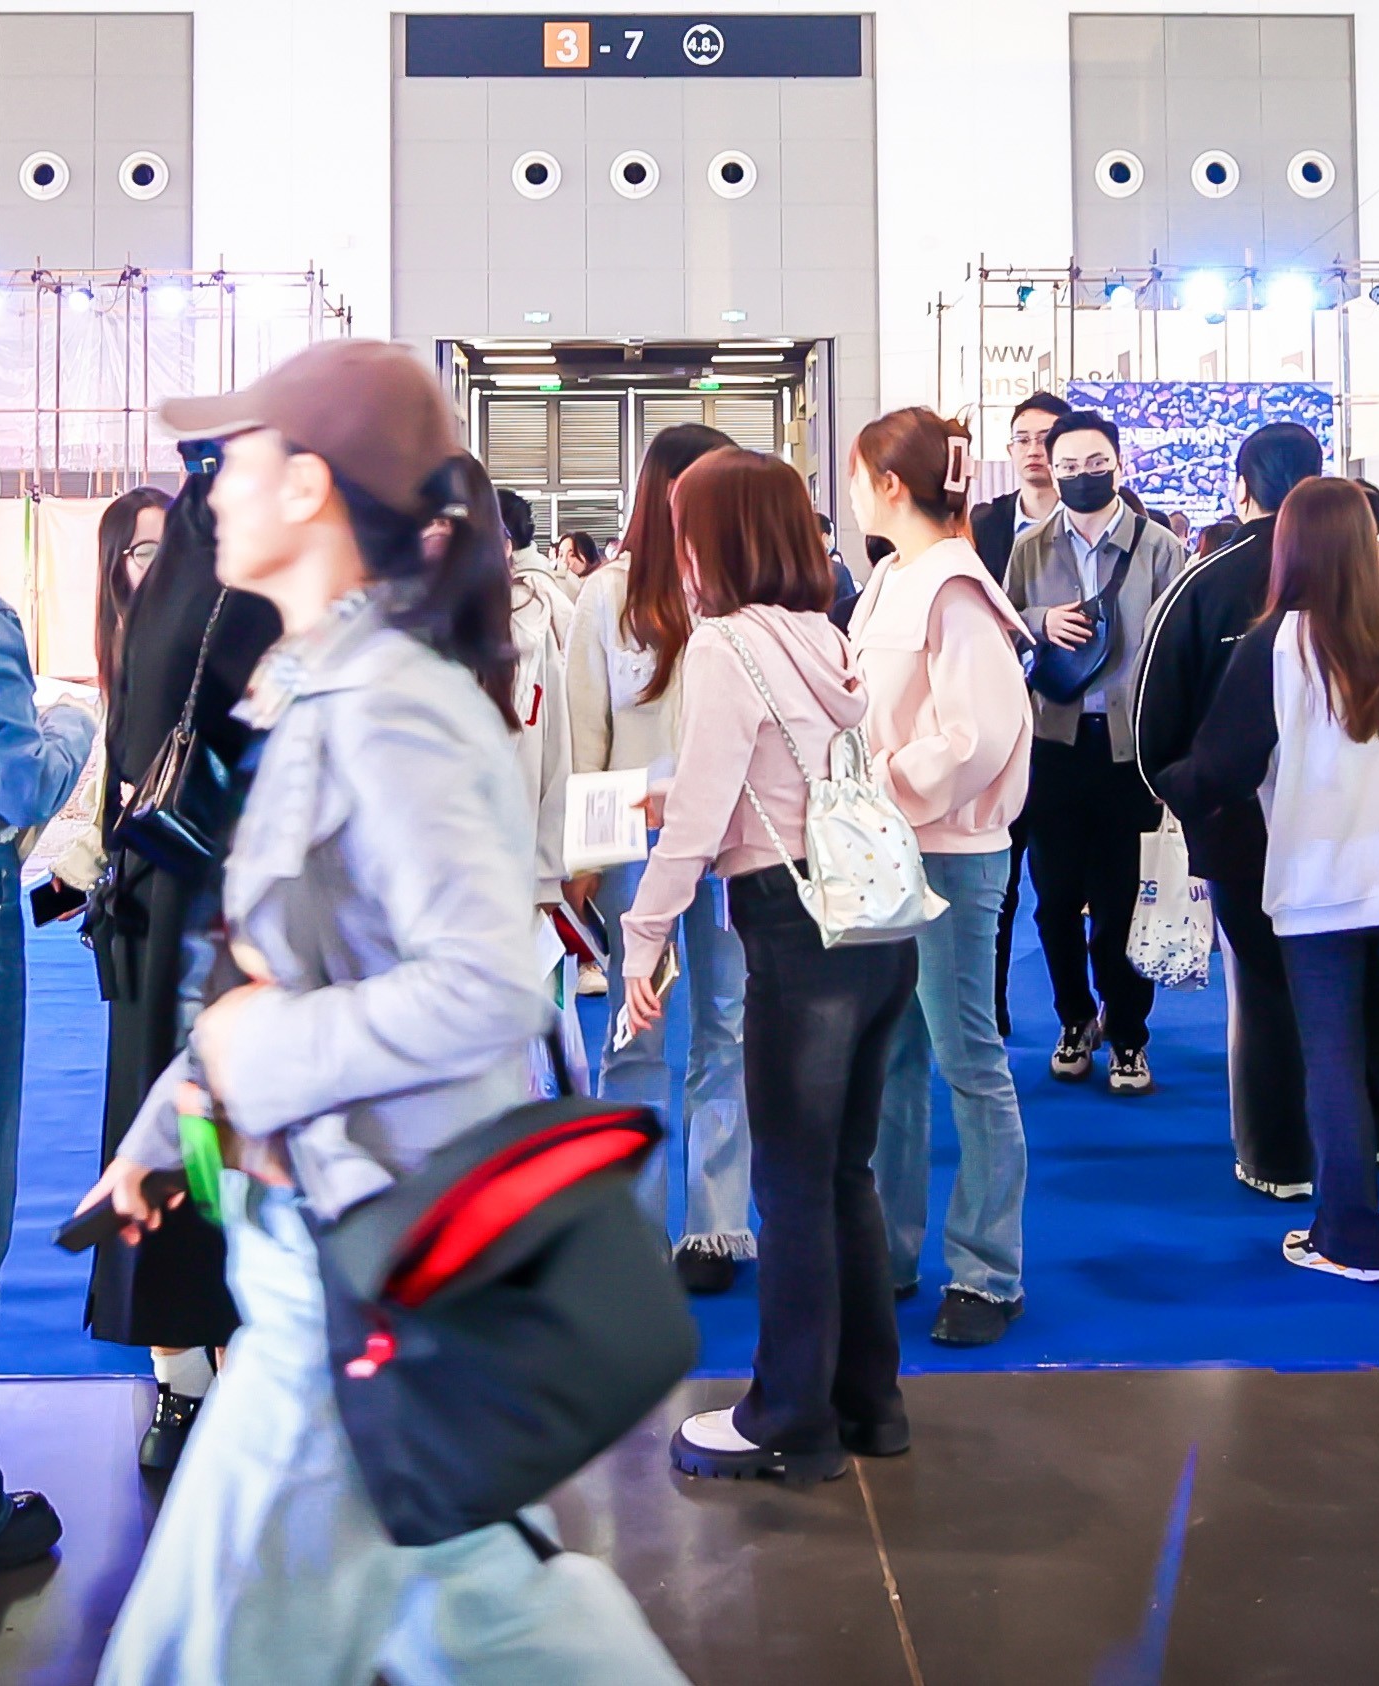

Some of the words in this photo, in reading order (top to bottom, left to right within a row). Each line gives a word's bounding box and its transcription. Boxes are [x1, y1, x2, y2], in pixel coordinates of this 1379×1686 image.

[556, 29, 578, 63] 3
[624, 30, 644, 60] 7
[1119, 426, 1226, 445] ENERATION
